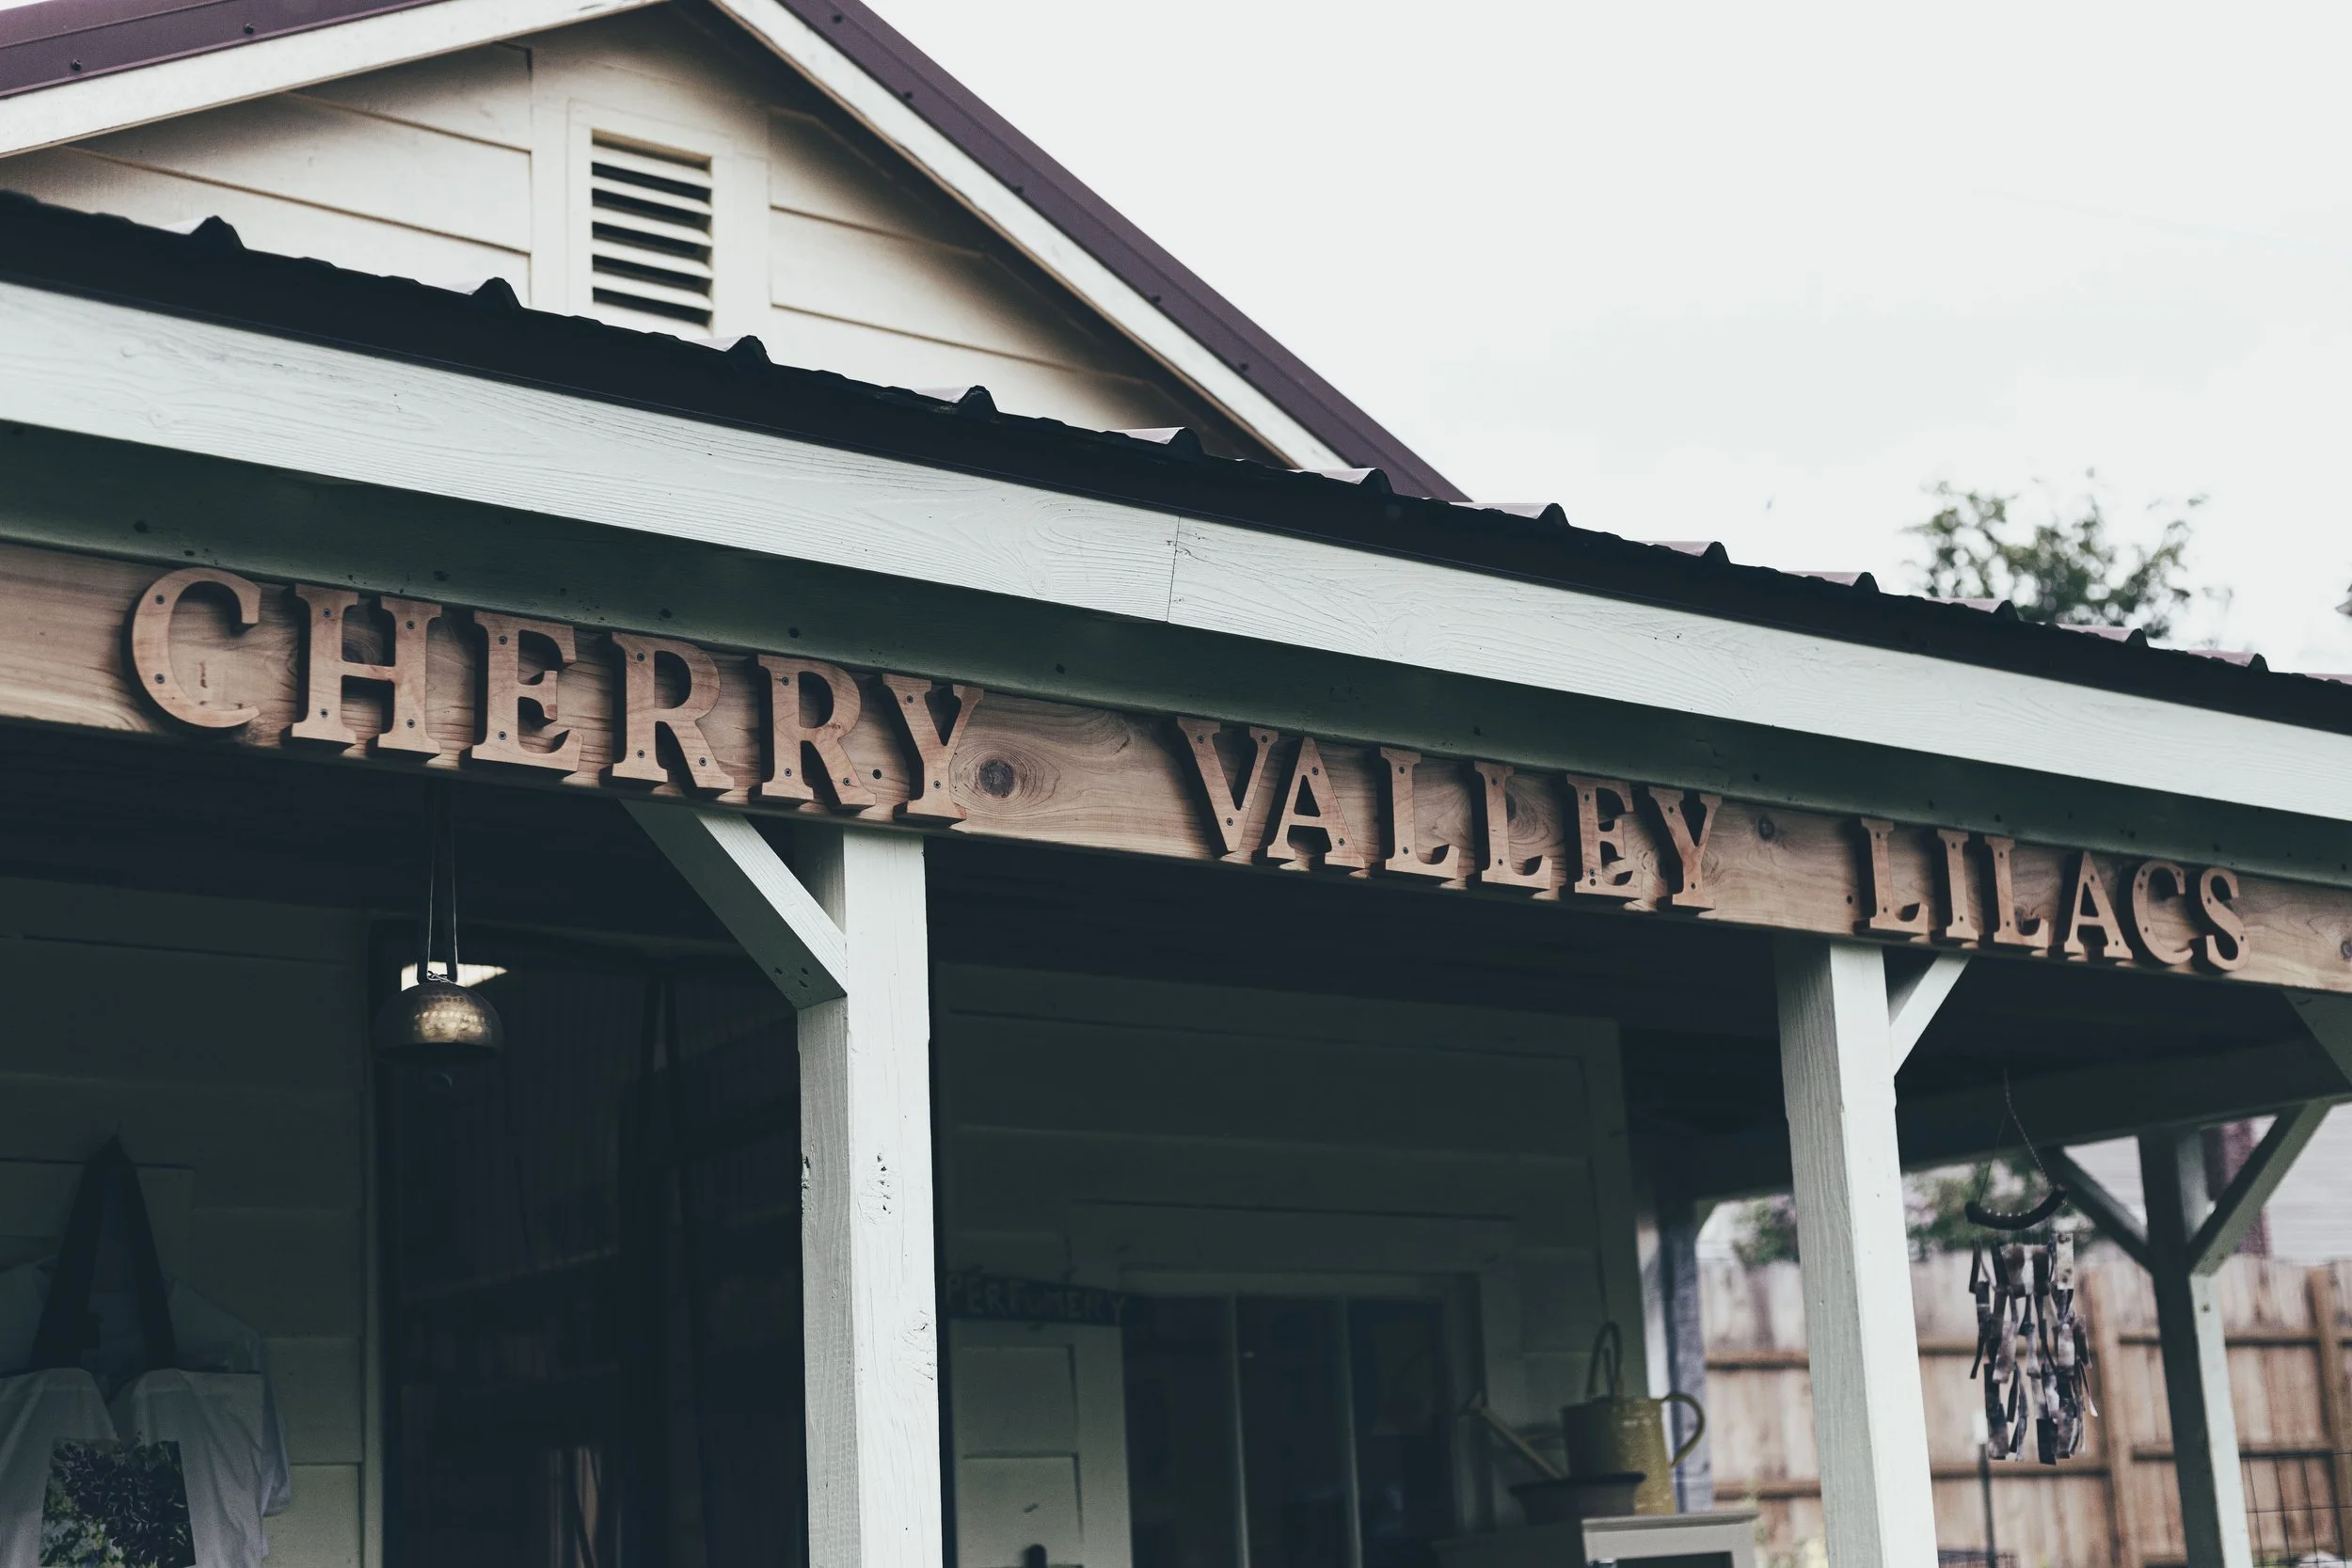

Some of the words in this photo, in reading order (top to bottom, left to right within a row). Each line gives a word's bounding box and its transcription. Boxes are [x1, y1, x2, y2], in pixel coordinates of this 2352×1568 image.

[132, 566, 985, 821] CHERRY
[1176, 715, 1723, 911] VALLEY
[1859, 816, 2250, 972] LILACS
